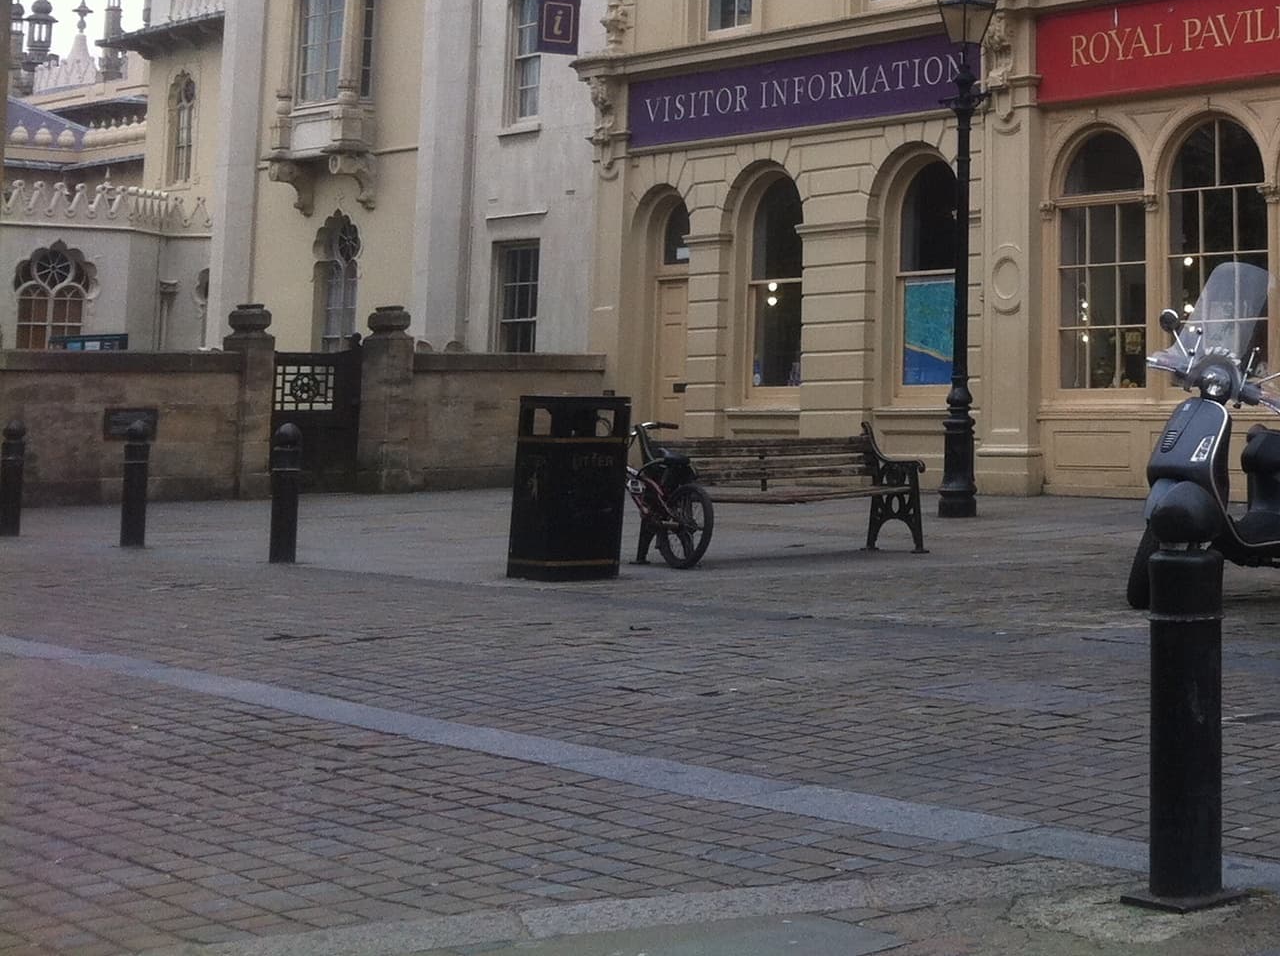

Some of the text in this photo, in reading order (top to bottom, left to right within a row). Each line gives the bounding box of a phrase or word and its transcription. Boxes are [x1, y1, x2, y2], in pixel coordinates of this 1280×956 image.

[1070, 24, 1173, 68] ROYAL
[645, 51, 964, 125] VISITOR INFORMATION
